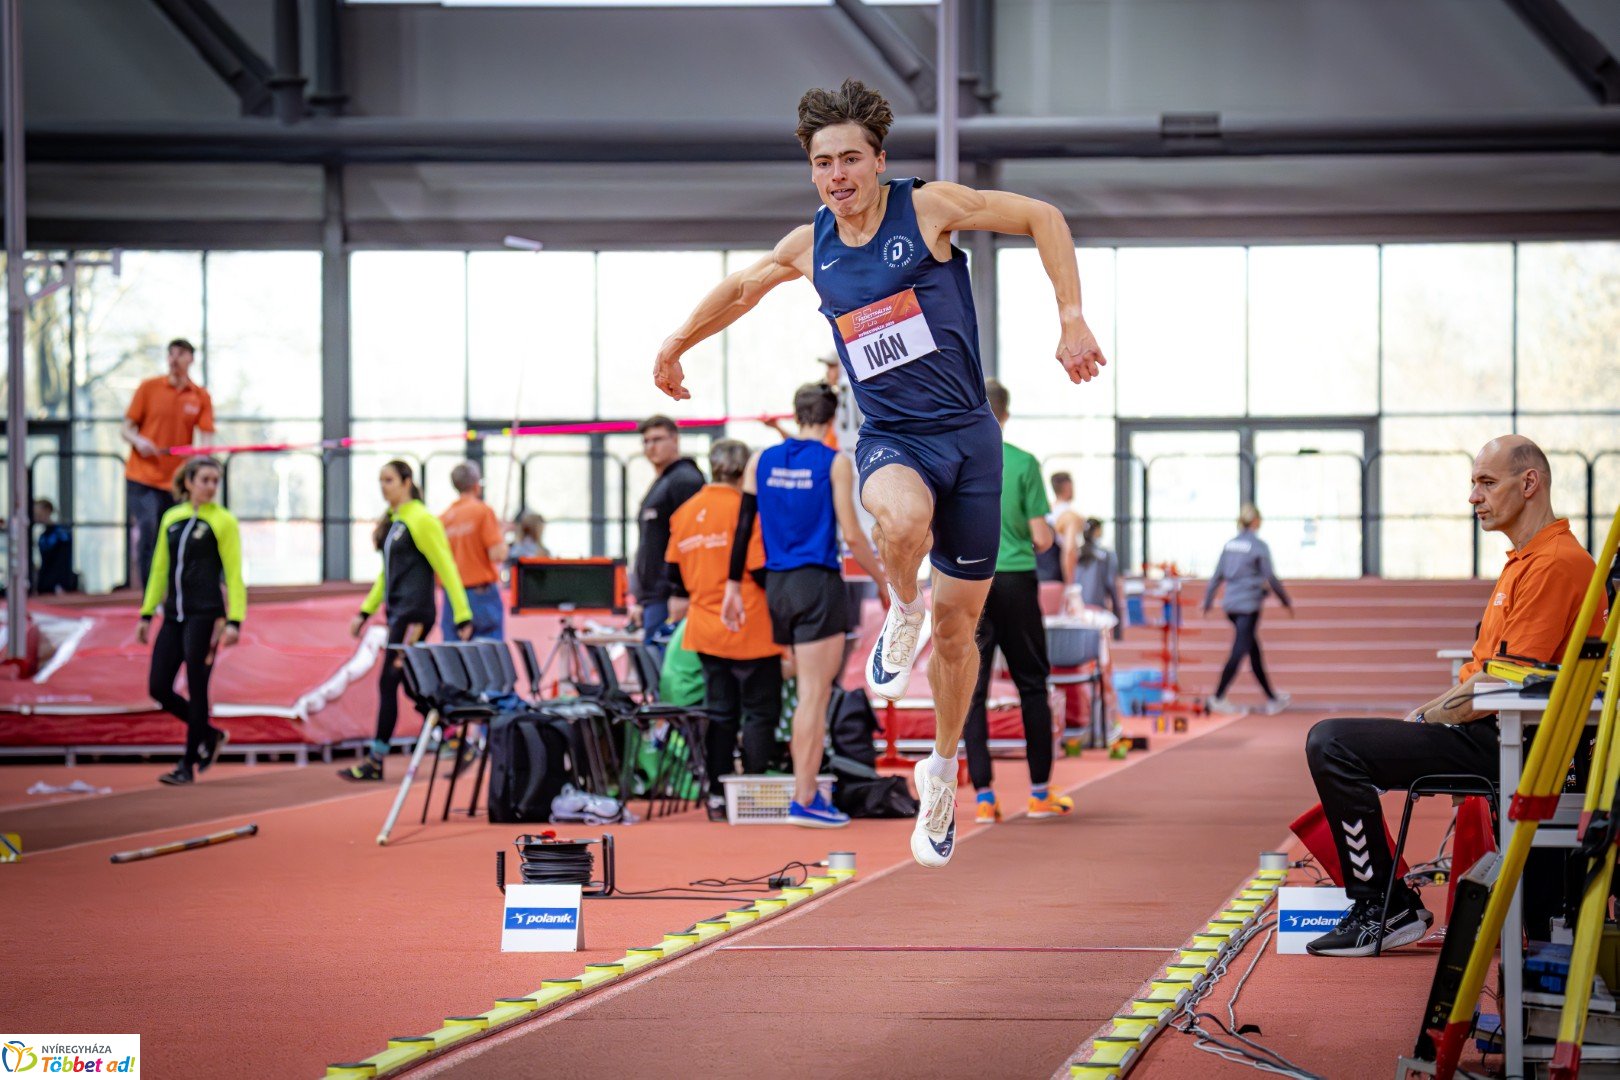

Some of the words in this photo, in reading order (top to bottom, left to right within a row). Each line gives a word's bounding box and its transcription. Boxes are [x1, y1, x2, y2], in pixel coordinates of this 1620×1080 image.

[862, 332, 909, 371] IVÁN
[525, 912, 572, 926] polanik
[1300, 915, 1344, 928] polani
